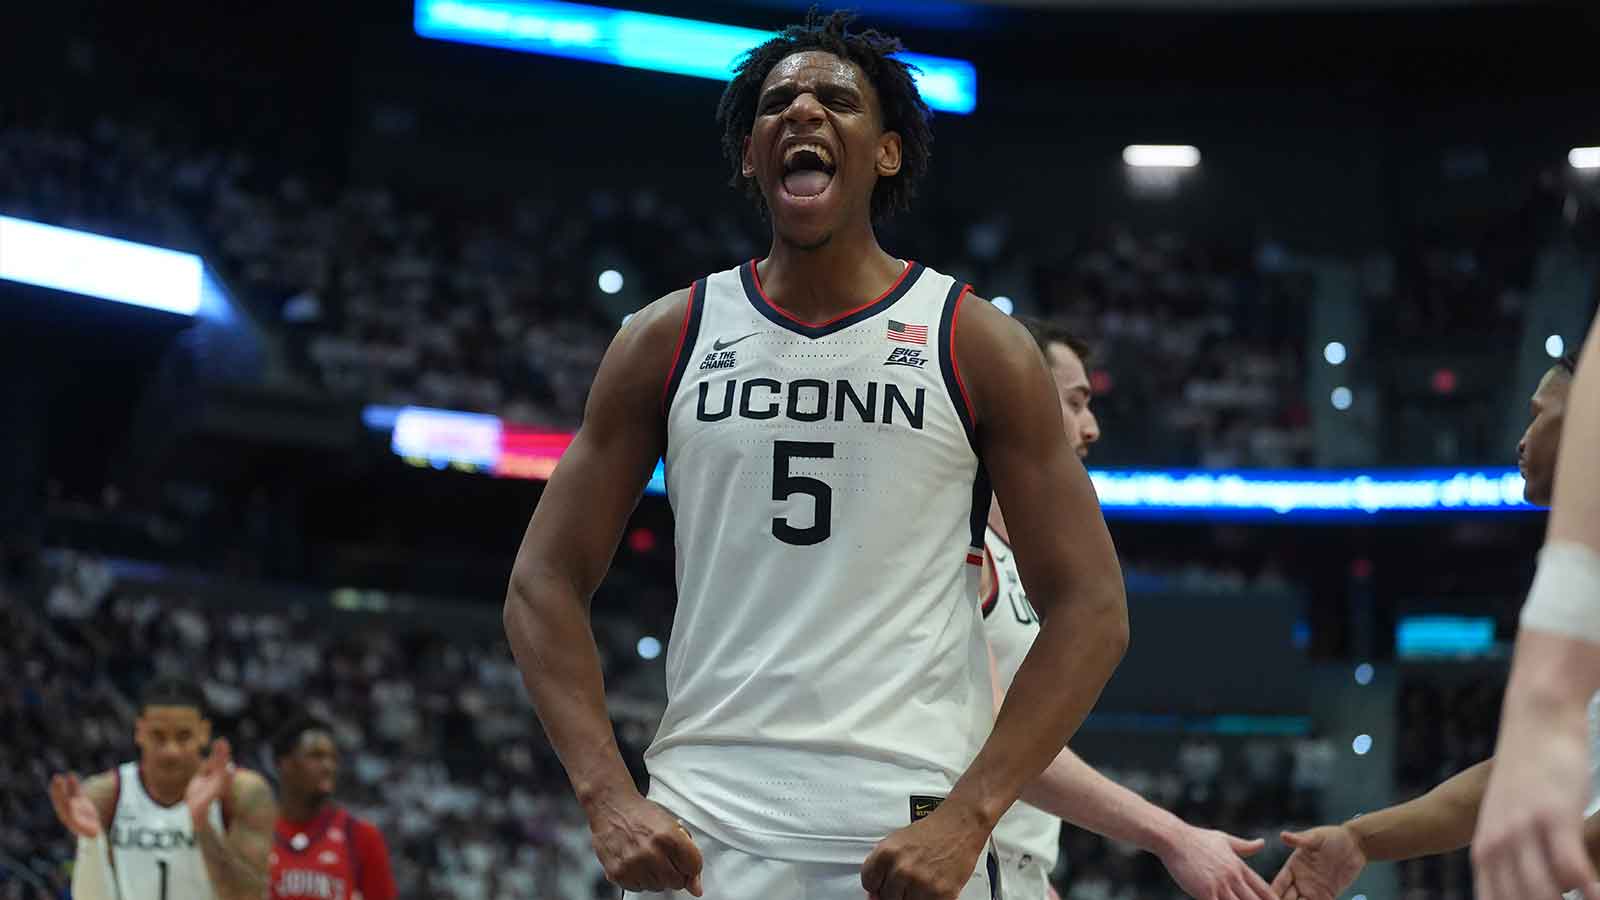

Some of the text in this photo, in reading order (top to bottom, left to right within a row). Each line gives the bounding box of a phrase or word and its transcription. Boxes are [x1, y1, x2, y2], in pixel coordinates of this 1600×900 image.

[705, 350, 737, 361] BE THE
[892, 347, 922, 357] BIG
[699, 359, 736, 370] CHANGE
[887, 354, 929, 366] EAST
[696, 378, 926, 430] UCONN
[771, 440, 834, 546] 5
